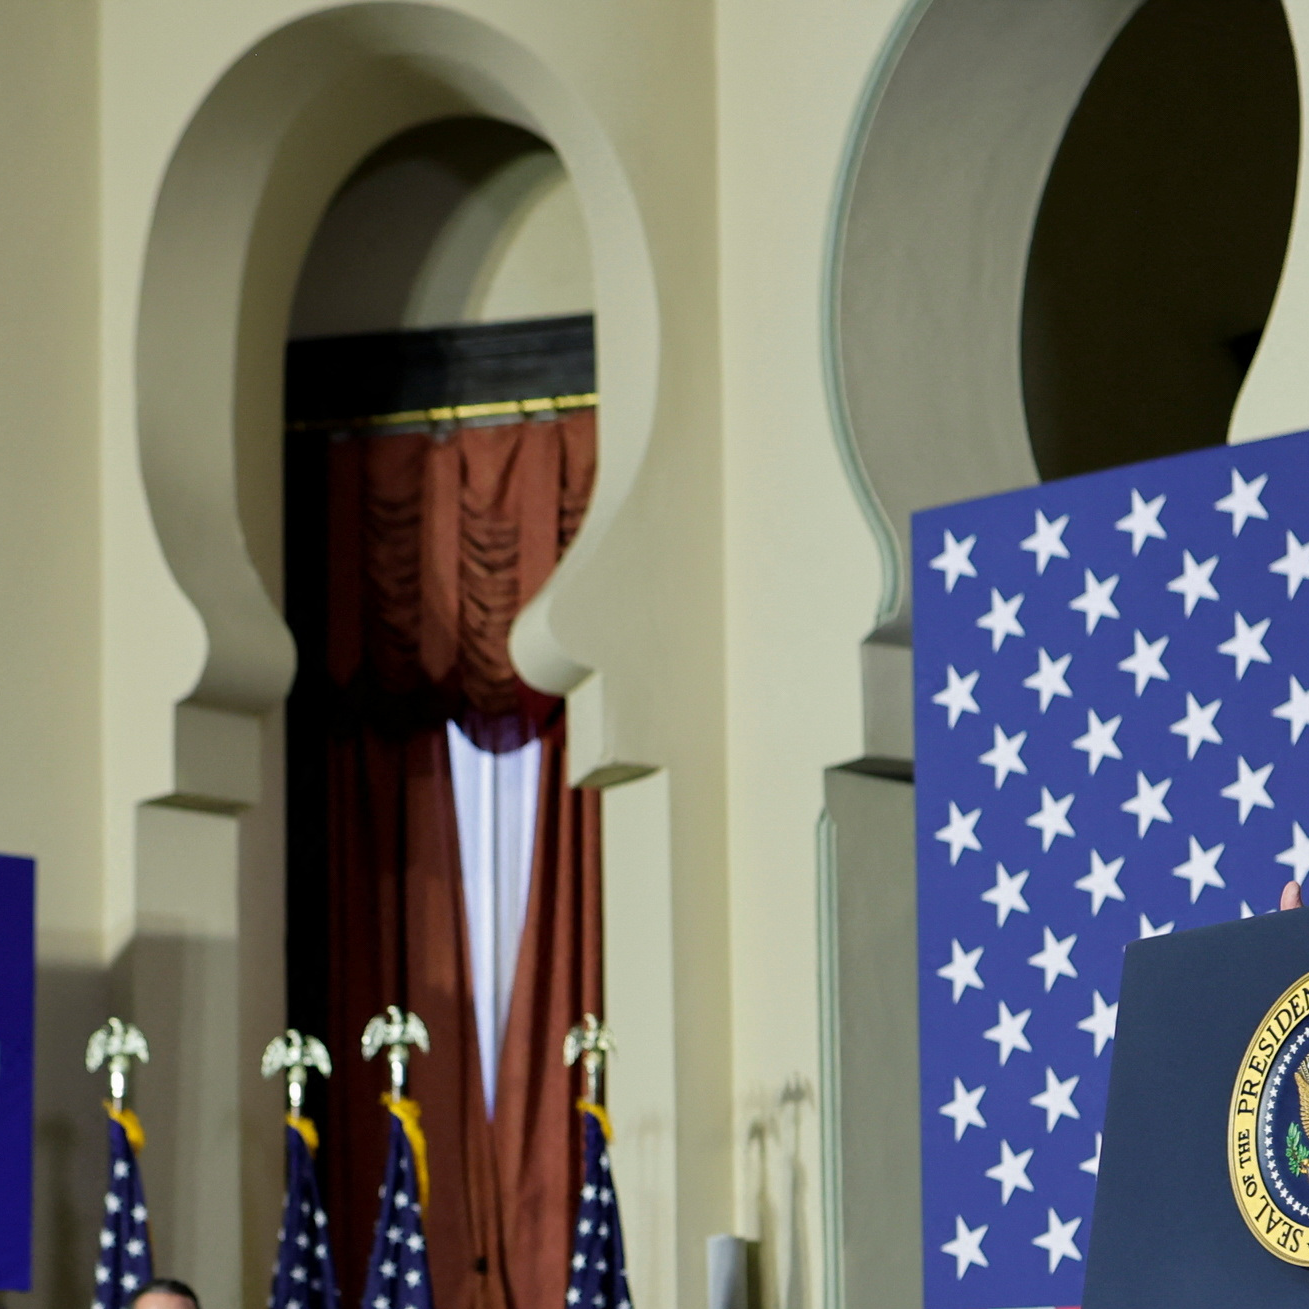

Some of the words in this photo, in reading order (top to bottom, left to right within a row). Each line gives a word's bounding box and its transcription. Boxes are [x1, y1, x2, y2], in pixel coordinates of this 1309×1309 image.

[1237, 1128, 1251, 1169] THE
[1242, 1174, 1258, 1198] OF
[1254, 1195, 1304, 1253] SEAL
